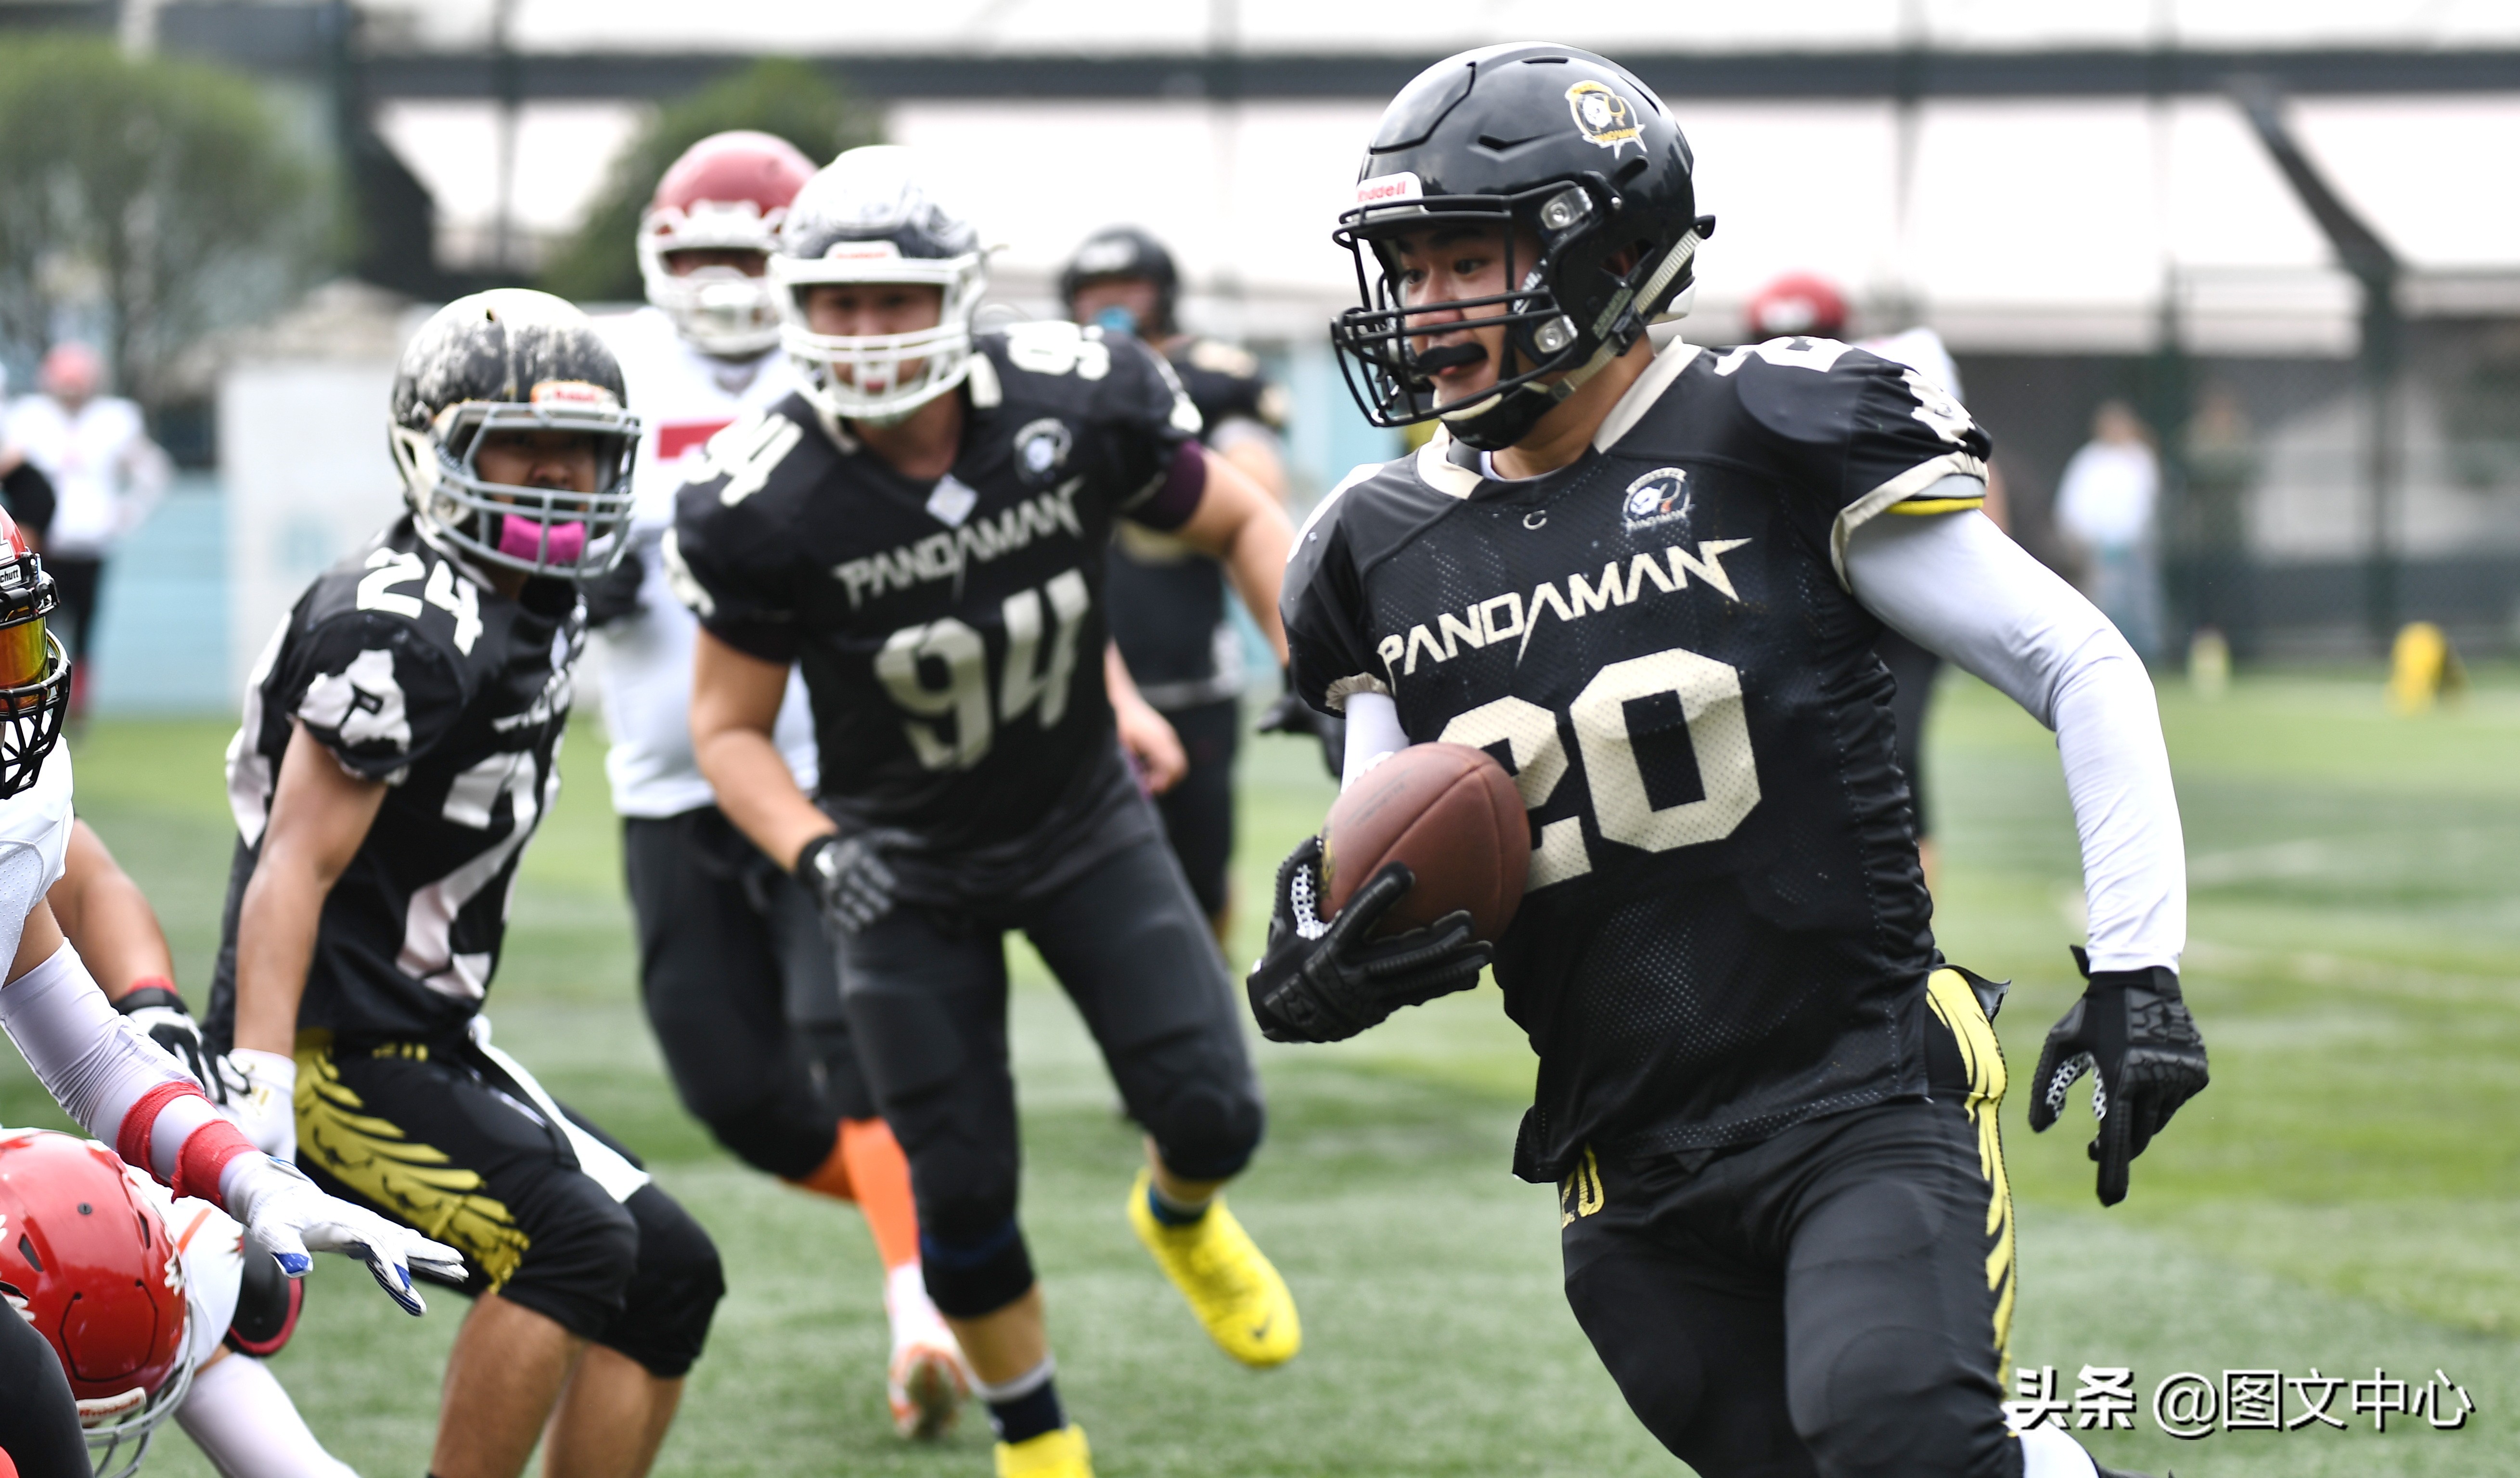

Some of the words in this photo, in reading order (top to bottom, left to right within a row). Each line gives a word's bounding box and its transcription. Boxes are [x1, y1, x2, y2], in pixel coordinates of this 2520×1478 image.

[356, 547, 483, 656] 24
[873, 567, 1091, 770] 94
[1376, 537, 1753, 697] PANDAMAN
